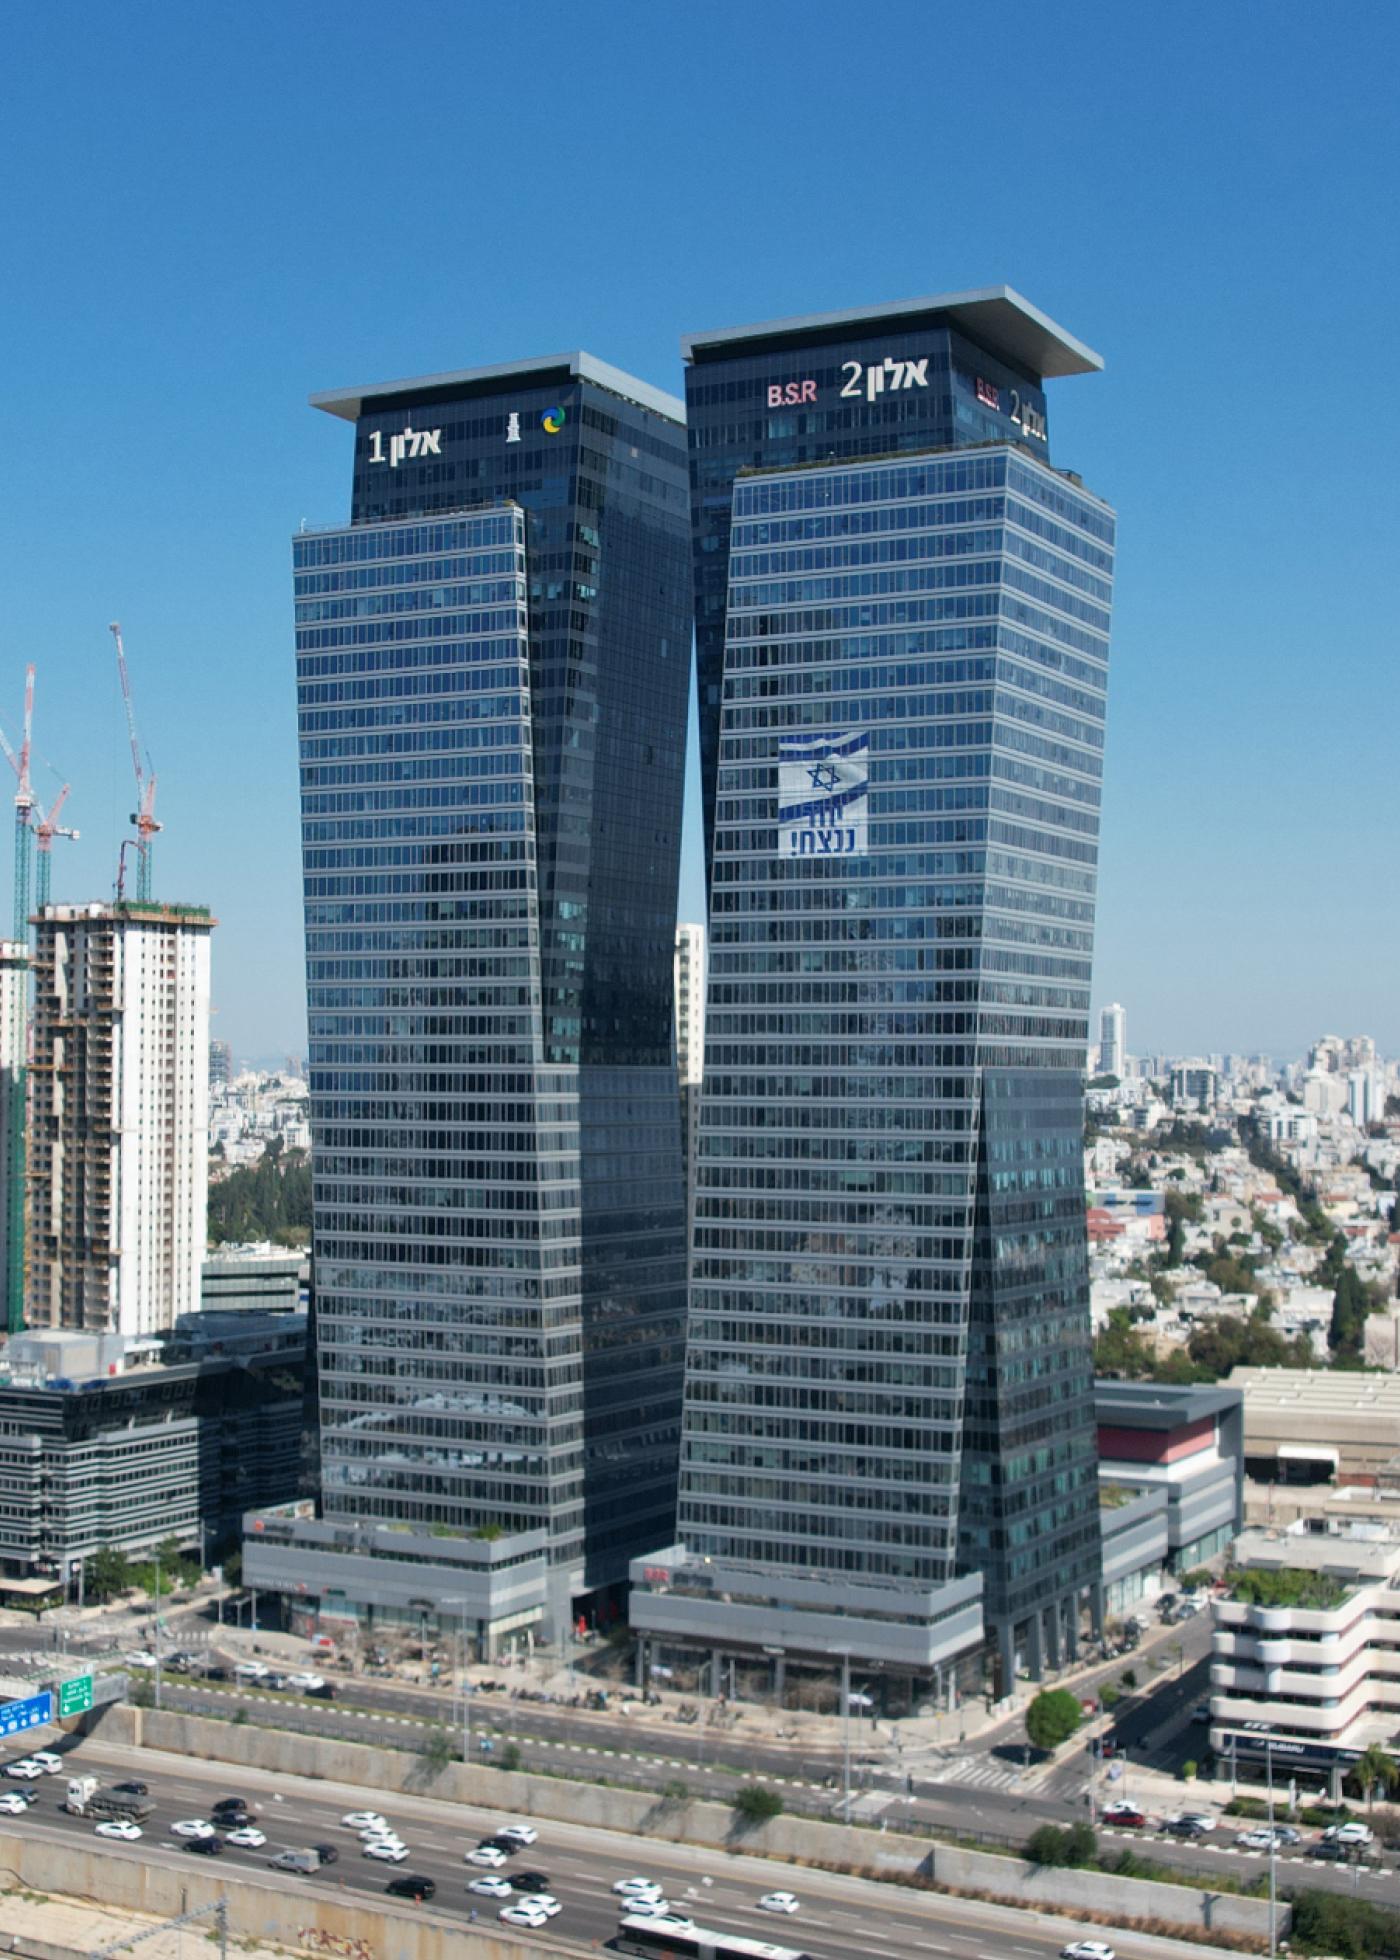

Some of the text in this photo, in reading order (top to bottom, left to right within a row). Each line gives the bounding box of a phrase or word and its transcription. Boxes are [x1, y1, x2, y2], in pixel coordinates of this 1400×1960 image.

[768, 380, 817, 408] B.S.R
[840, 357, 929, 401] אלון 2
[1010, 390, 1021, 424] 2
[369, 427, 442, 467] אלון 1
[791, 829, 855, 856] ננצח!
